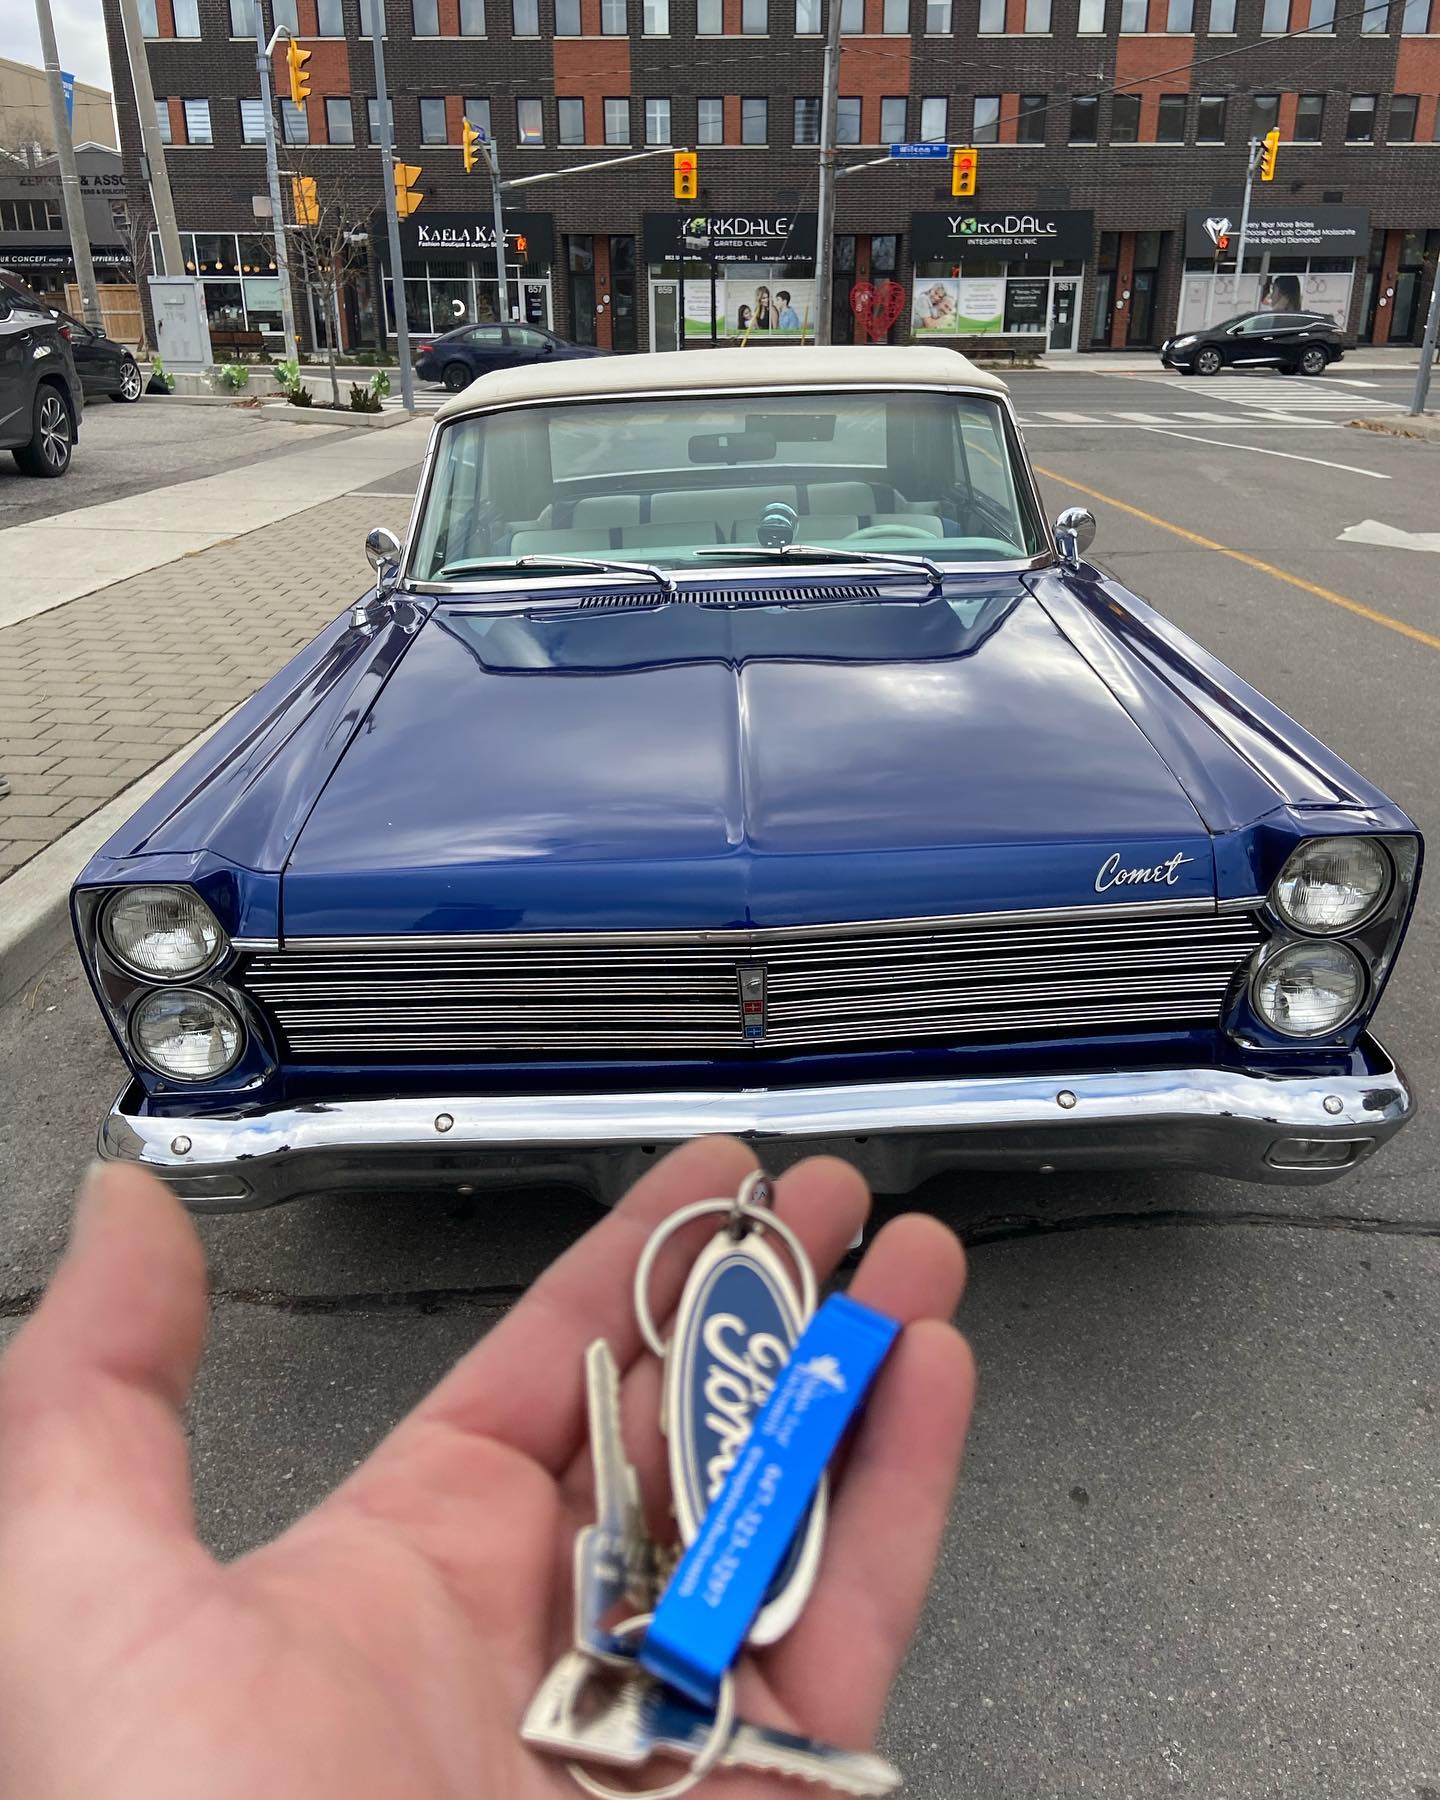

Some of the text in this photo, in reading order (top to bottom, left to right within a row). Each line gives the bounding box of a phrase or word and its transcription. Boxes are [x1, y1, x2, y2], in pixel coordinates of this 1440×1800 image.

[80, 175, 89, 186] &
[1244, 221, 1260, 230] very
[418, 225, 471, 242] KAELA
[1013, 237, 1038, 245] CLINIC
[12, 255, 47, 263] CONCEPT
[1094, 852, 1195, 893] Comet
